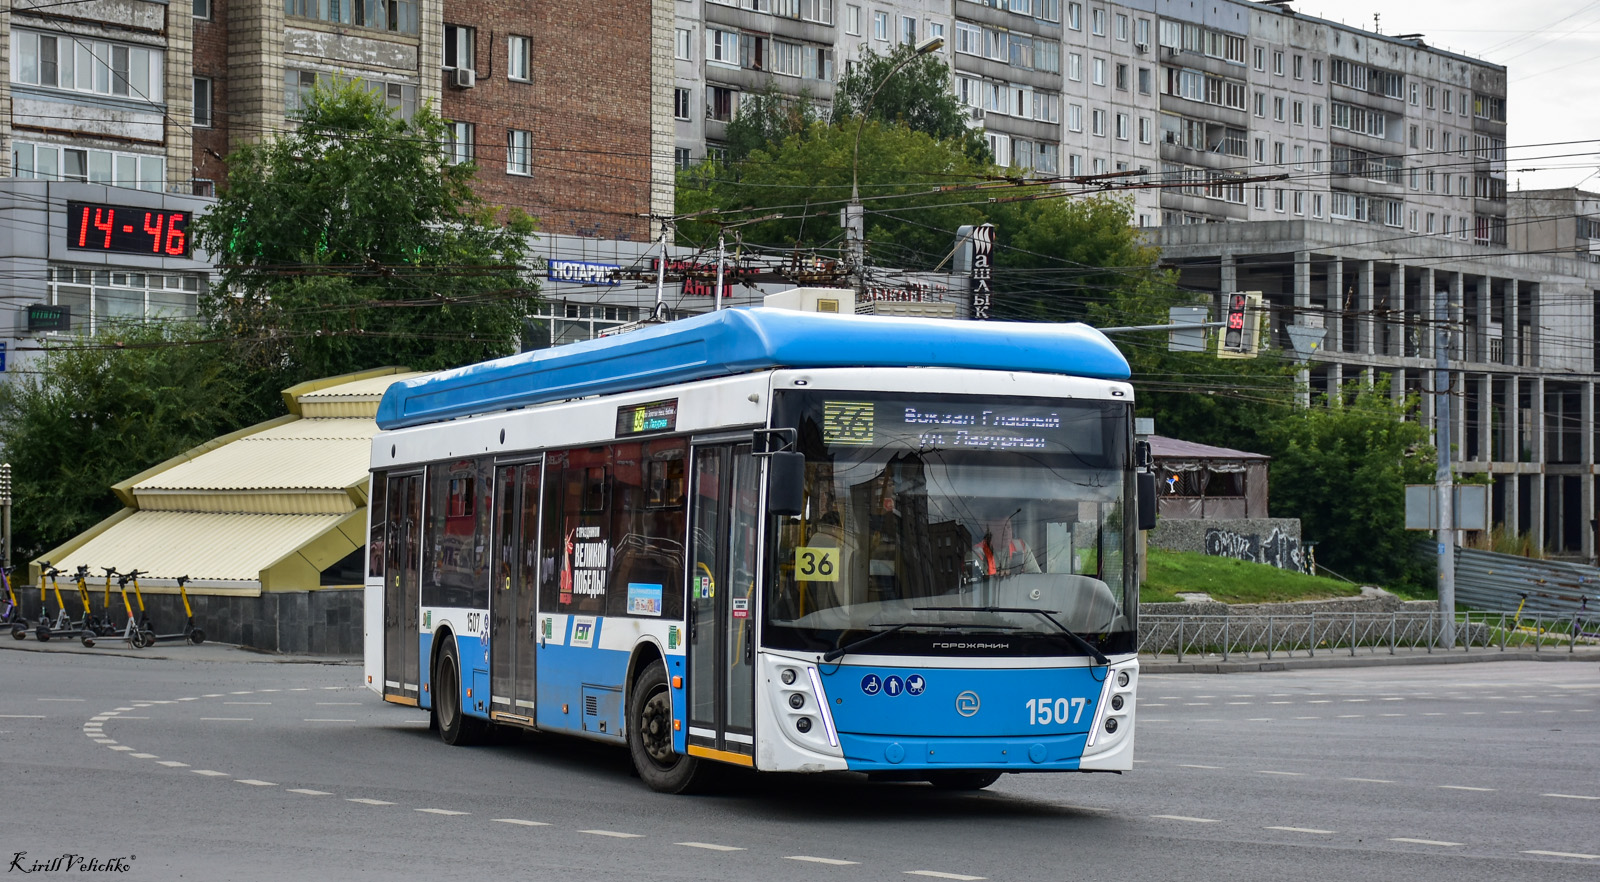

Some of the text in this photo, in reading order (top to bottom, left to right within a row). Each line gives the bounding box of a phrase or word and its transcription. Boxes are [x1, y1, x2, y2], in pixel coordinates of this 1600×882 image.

[78, 206, 186, 256] 14-46
[904, 407, 1060, 428] Вокзал Главный
[574, 539, 608, 568] ВЕЛИКОЙ
[800, 552, 834, 576] 36
[573, 569, 606, 599] ПОБЕДЫ!
[466, 612, 480, 633] 1507
[1025, 697, 1087, 725] 1507
